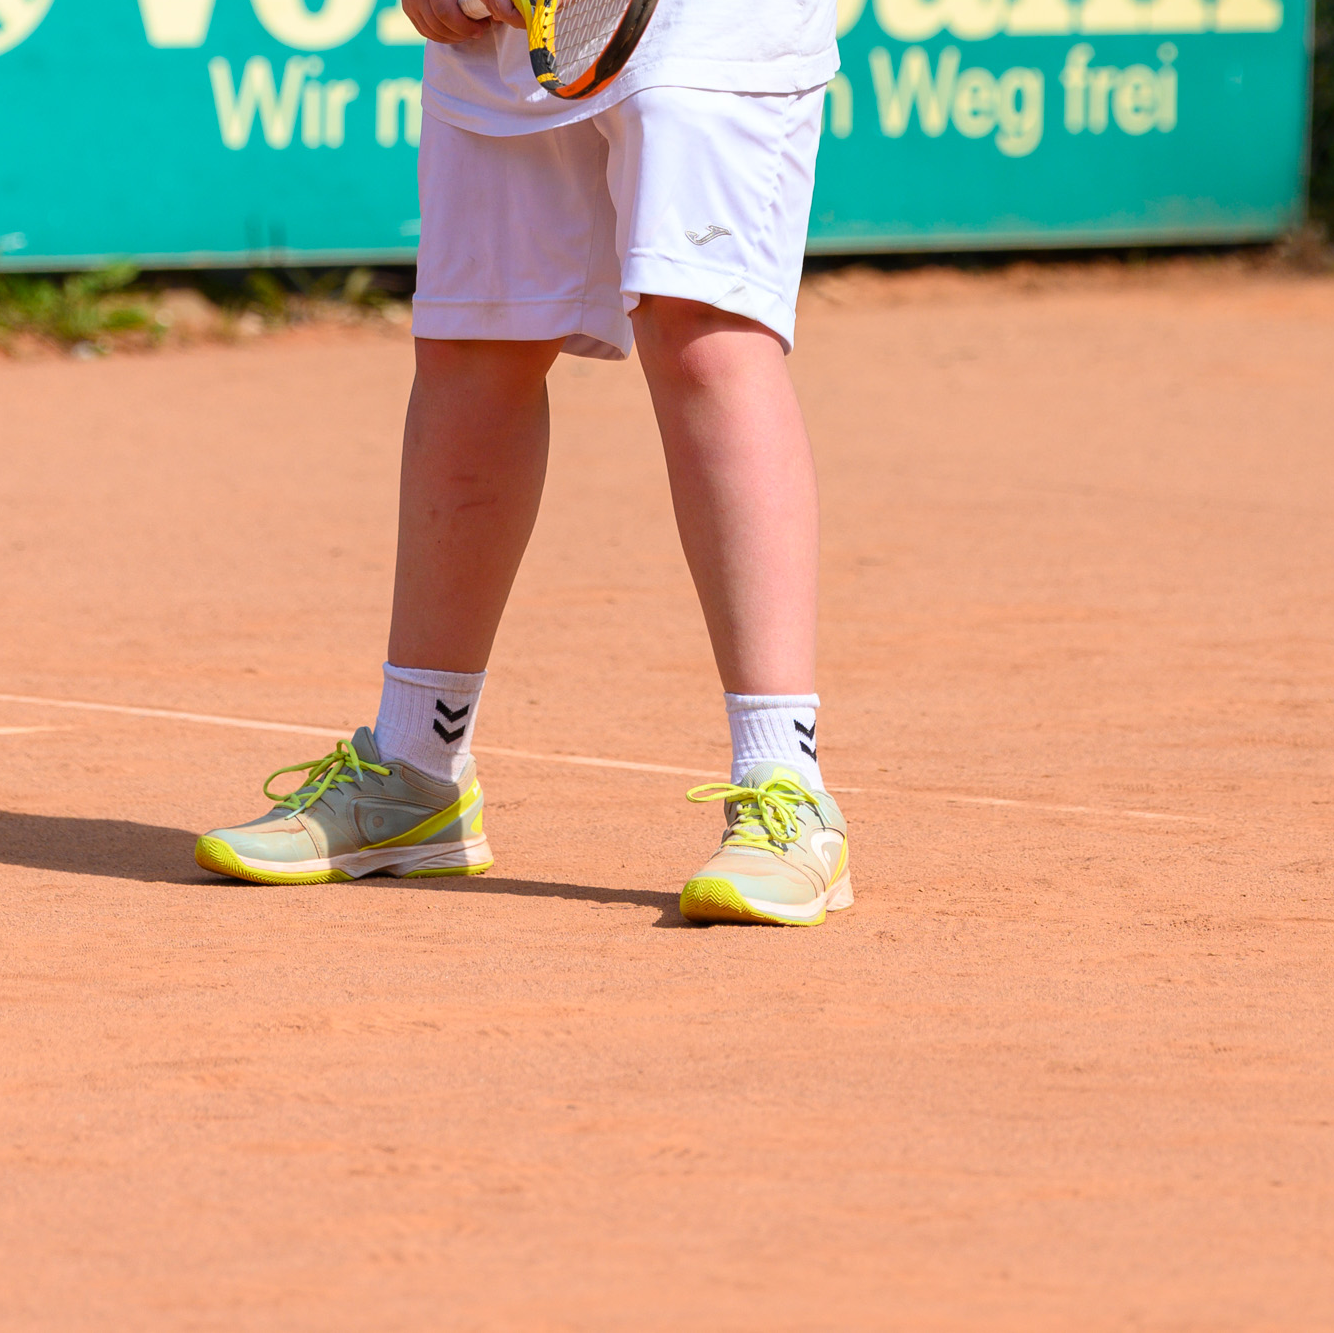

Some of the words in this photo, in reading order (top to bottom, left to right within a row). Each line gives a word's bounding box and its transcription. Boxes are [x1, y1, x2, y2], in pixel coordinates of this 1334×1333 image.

[208, 55, 360, 150] Wir
[869, 45, 1045, 157] Weg
[1060, 43, 1179, 137] frei
